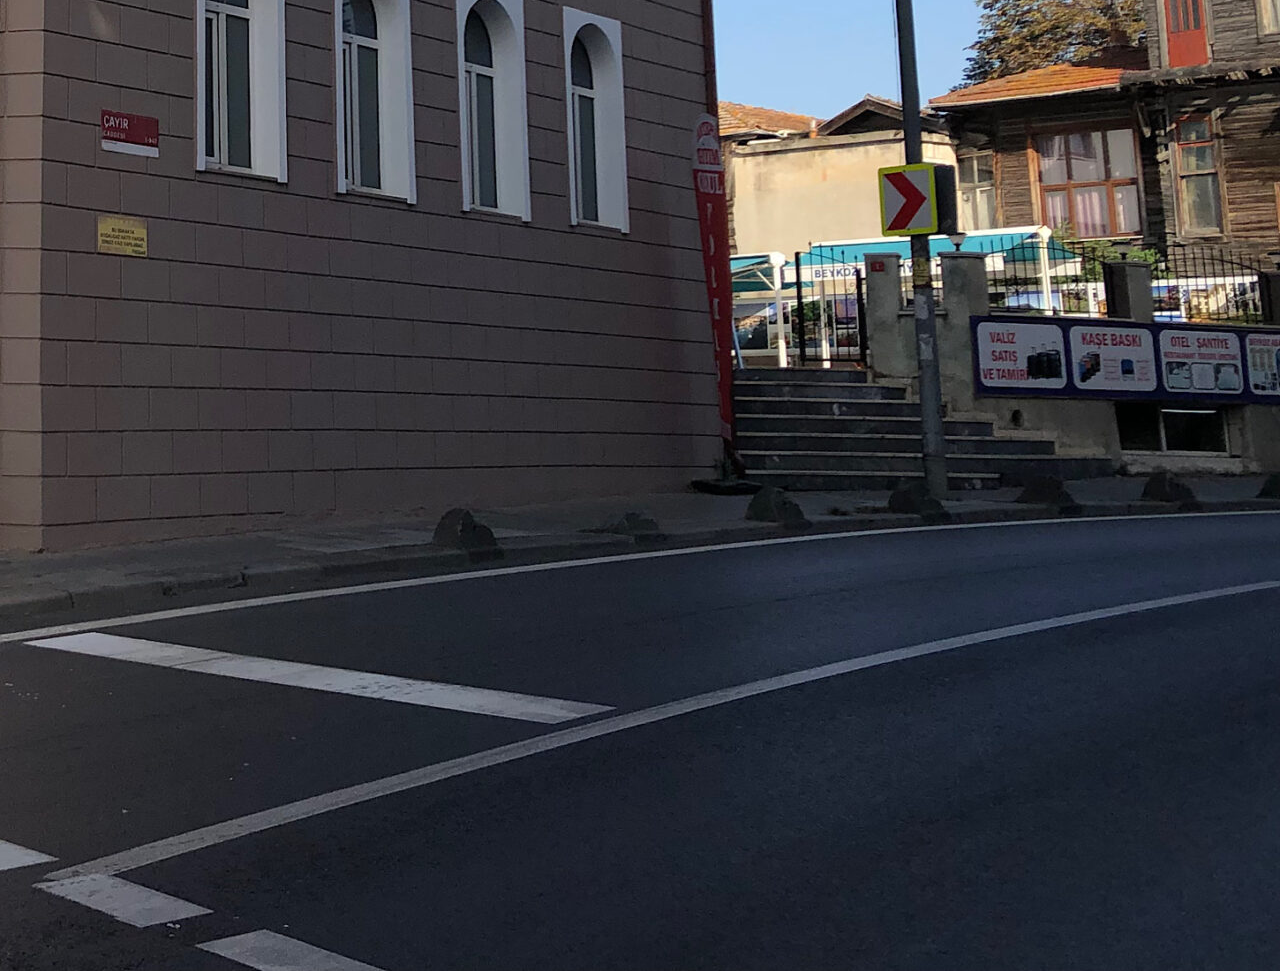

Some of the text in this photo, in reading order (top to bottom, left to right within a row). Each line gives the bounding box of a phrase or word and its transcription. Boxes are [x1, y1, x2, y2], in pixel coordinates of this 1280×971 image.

[103, 115, 129, 129] ÇAYIR
[989, 329, 1017, 344] VALİZ
[1081, 332, 1142, 348] KAŞE BASKI
[1170, 336, 1190, 348] OTEL
[991, 350, 1018, 365] SATIŞ
[982, 368, 995, 380] VE
